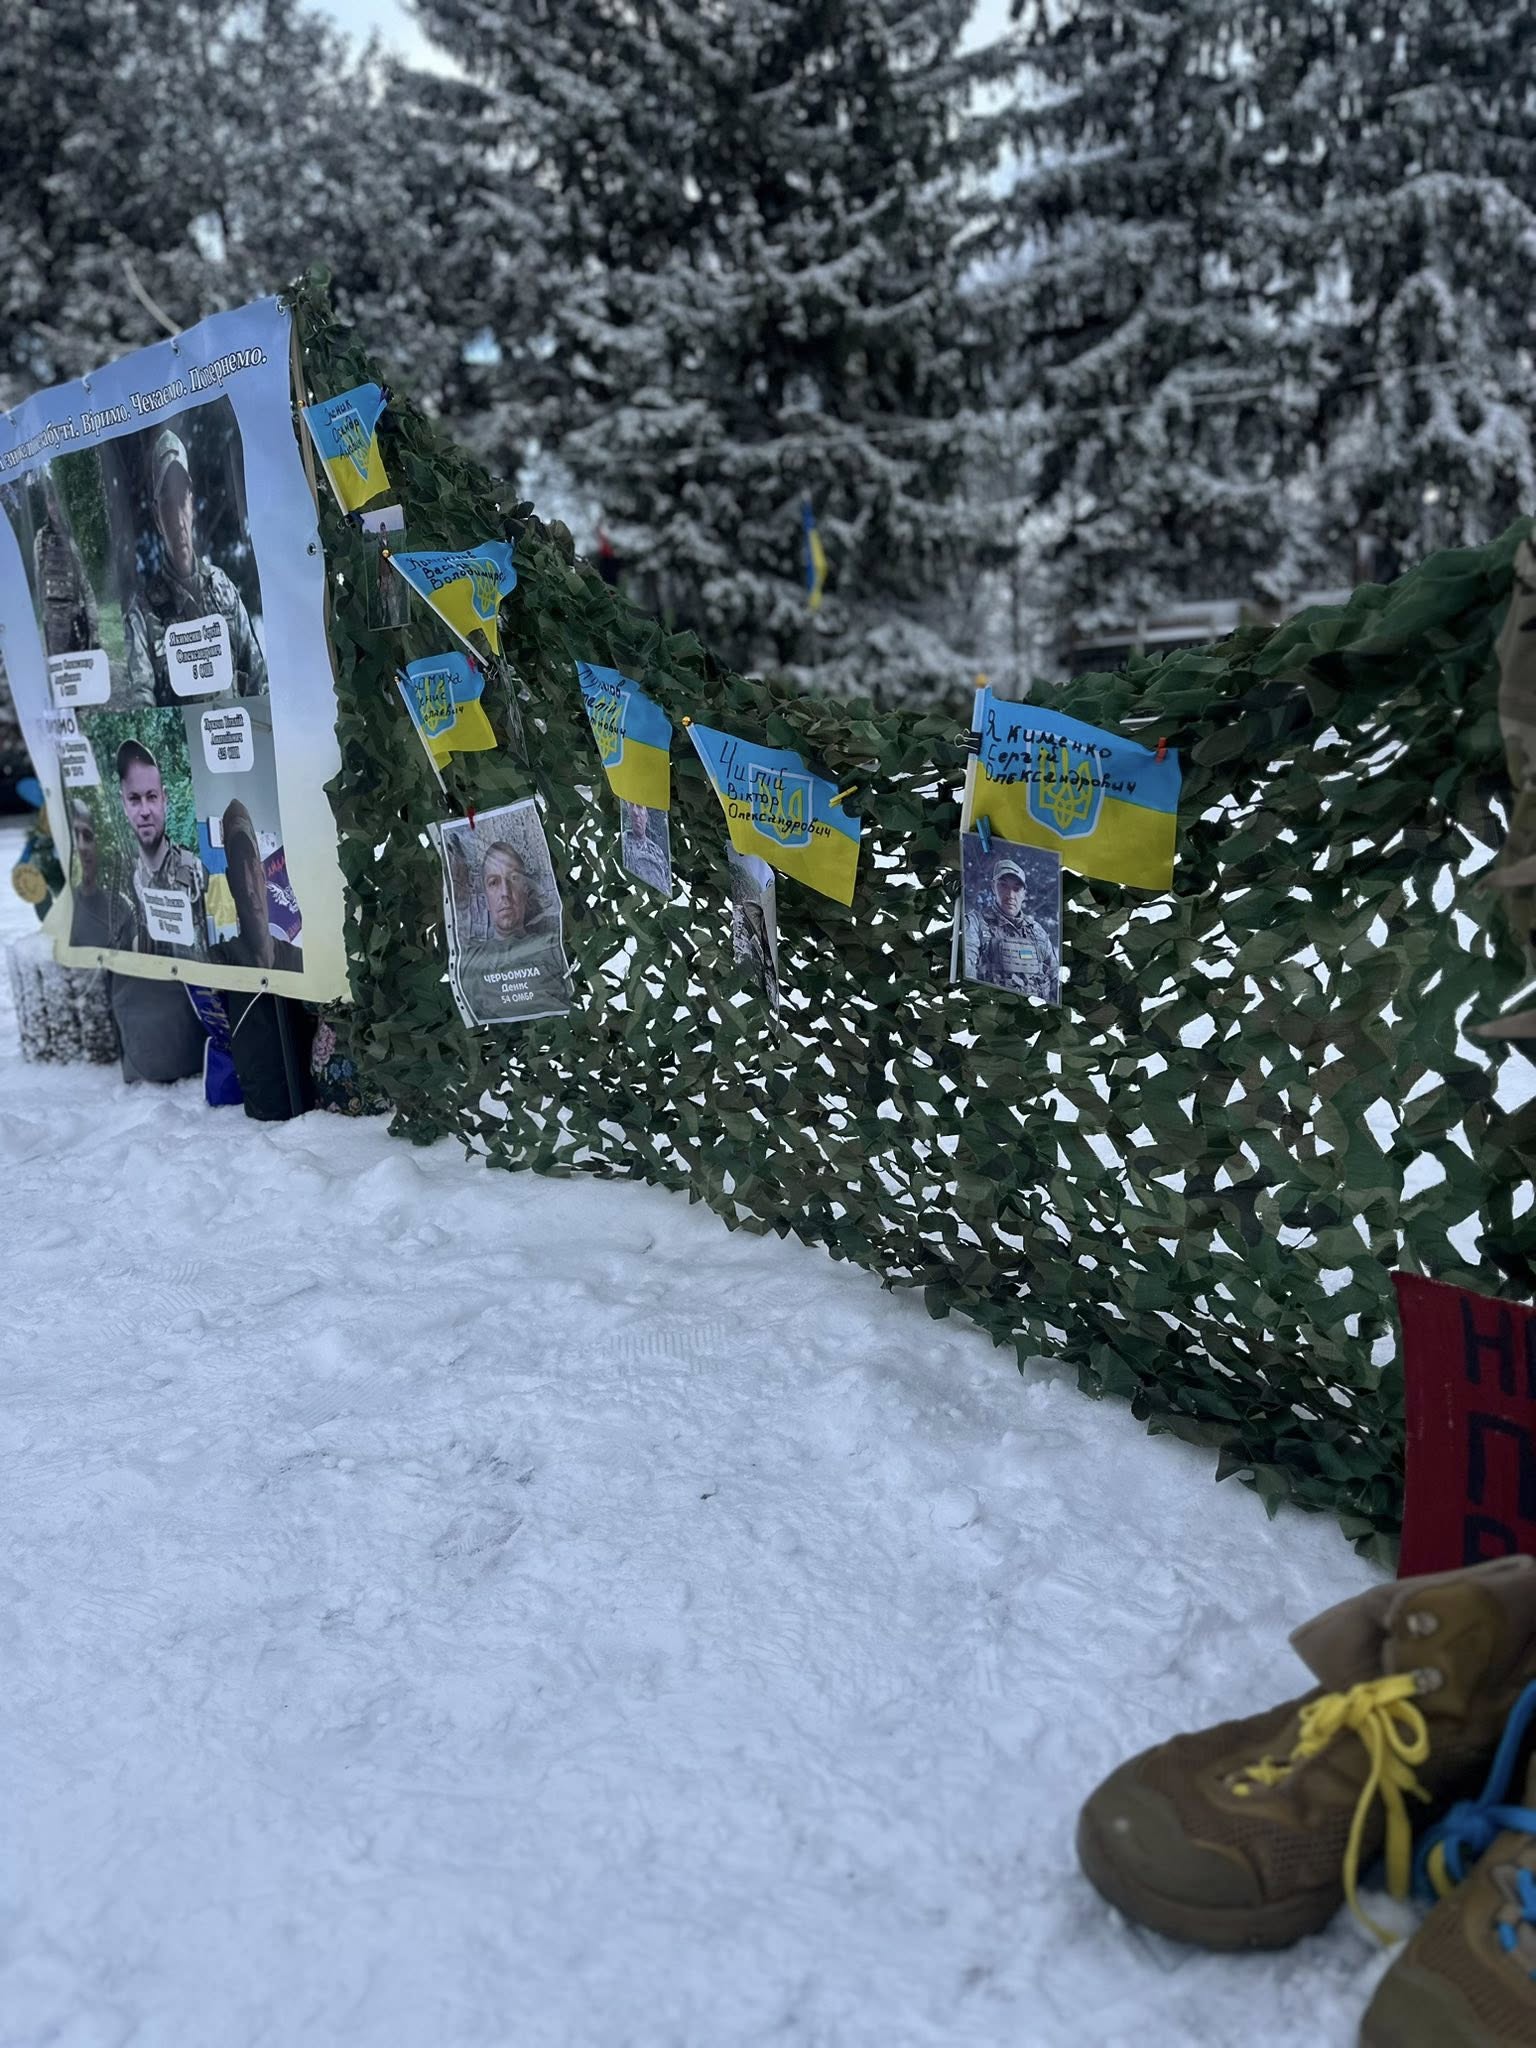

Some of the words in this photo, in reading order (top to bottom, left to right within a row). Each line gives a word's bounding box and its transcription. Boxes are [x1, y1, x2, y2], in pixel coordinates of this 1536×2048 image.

[81, 404, 131, 437] Віримо.
[129, 379, 188, 415] Чекаємо.
[188, 347, 268, 392] Повернемо.
[986, 709, 1112, 758] Якименко
[988, 744, 1059, 771] Сергій
[728, 782, 779, 813] Віктор
[728, 803, 831, 838] Олександрович
[483, 966, 541, 984] ЧЕРЬОМУХА
[501, 981, 529, 993] Денис
